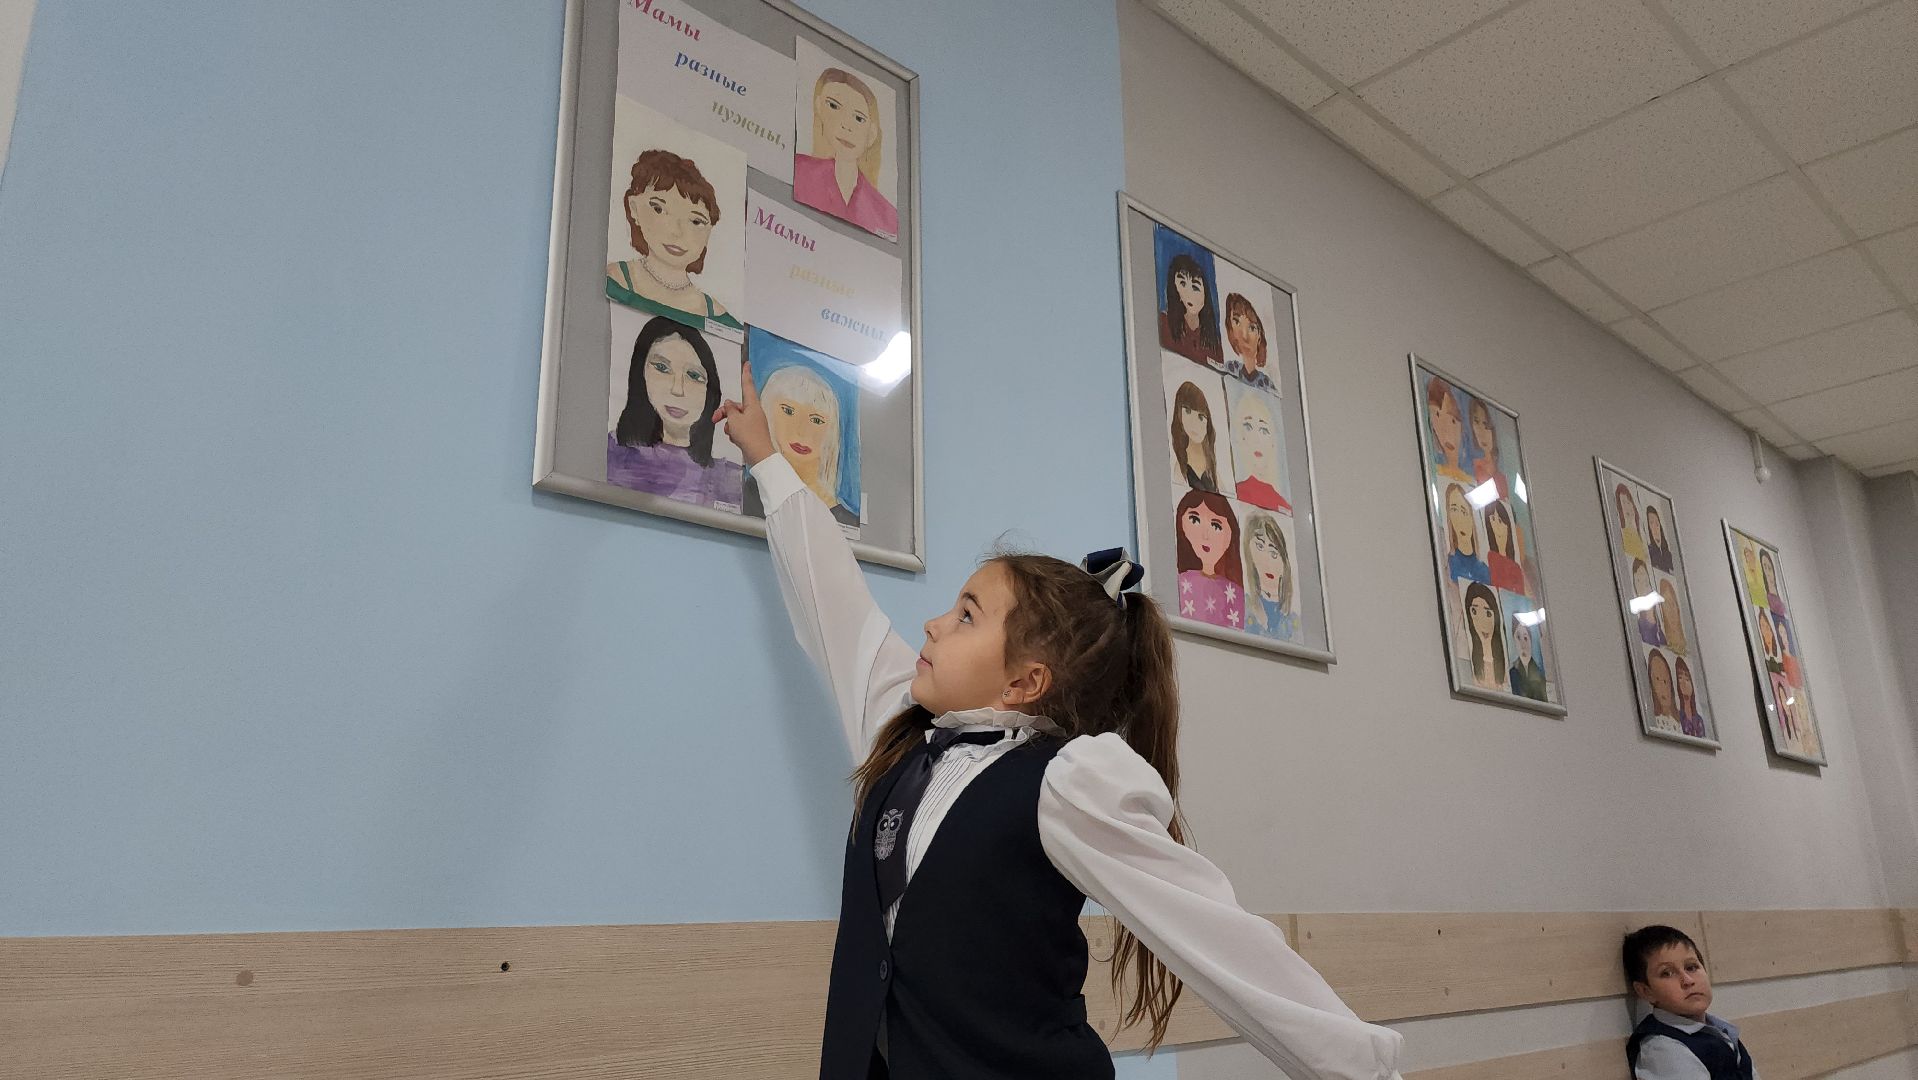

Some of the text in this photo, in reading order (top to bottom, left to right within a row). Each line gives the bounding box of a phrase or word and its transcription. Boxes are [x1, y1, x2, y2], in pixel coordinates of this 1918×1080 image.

[674, 51, 747, 97] разные
[712, 101, 786, 150] нужны,
[754, 207, 816, 251] Мамы
[789, 264, 855, 297] разные
